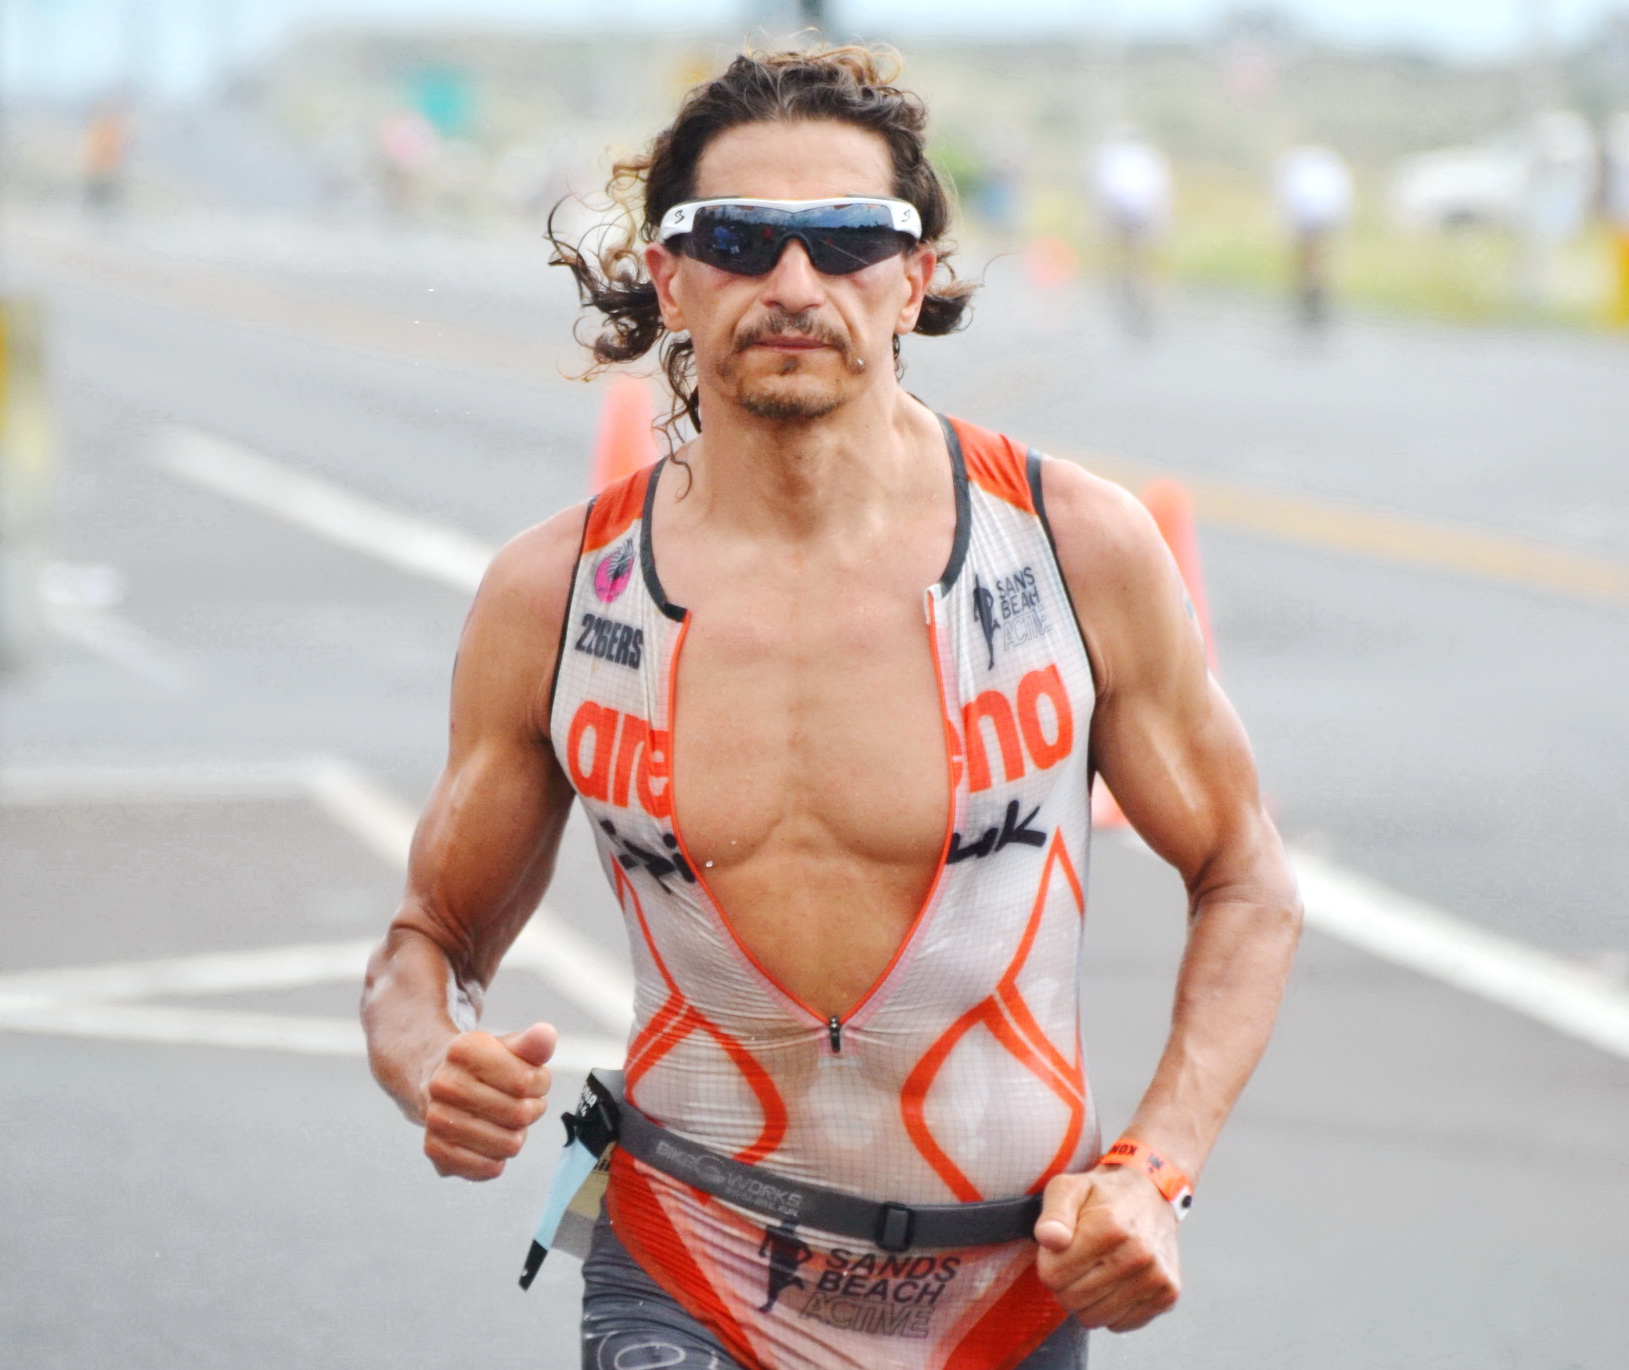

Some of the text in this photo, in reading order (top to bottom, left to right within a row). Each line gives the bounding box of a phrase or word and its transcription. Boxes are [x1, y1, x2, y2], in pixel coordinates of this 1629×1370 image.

[996, 566, 1036, 600] SANS
[825, 1248, 961, 1282] SANDS
[816, 1270, 946, 1306] BEACH
[801, 1293, 935, 1339] ACTIVE
